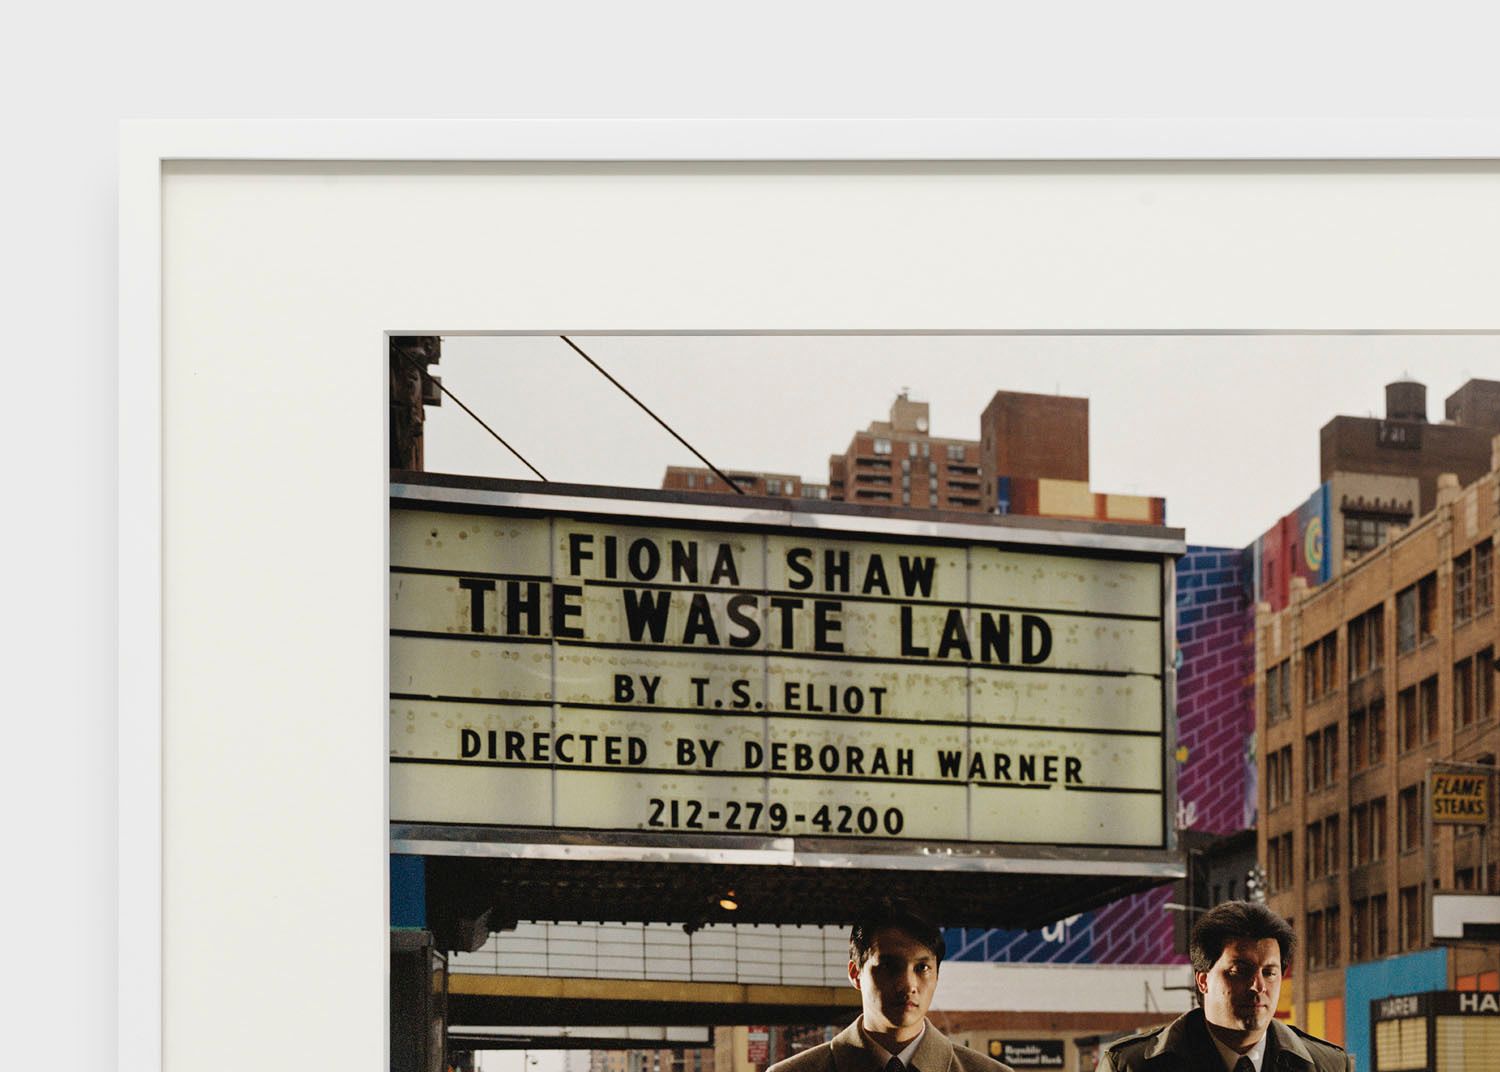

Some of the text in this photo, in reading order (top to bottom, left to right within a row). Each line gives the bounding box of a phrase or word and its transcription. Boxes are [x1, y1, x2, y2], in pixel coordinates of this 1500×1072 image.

[569, 533, 936, 597] FIONA SHAW
[459, 578, 1053, 664] THE WASTE LAND
[614, 674, 887, 715] BY T.S. ELIOT
[461, 729, 1083, 784] DIRECTED BY DEBORAH WARNER
[1434, 778, 1485, 796] FLAME
[1435, 799, 1485, 814] STEAKS
[648, 798, 904, 835] 212-279-4200
[1381, 997, 1418, 1016] HAREM
